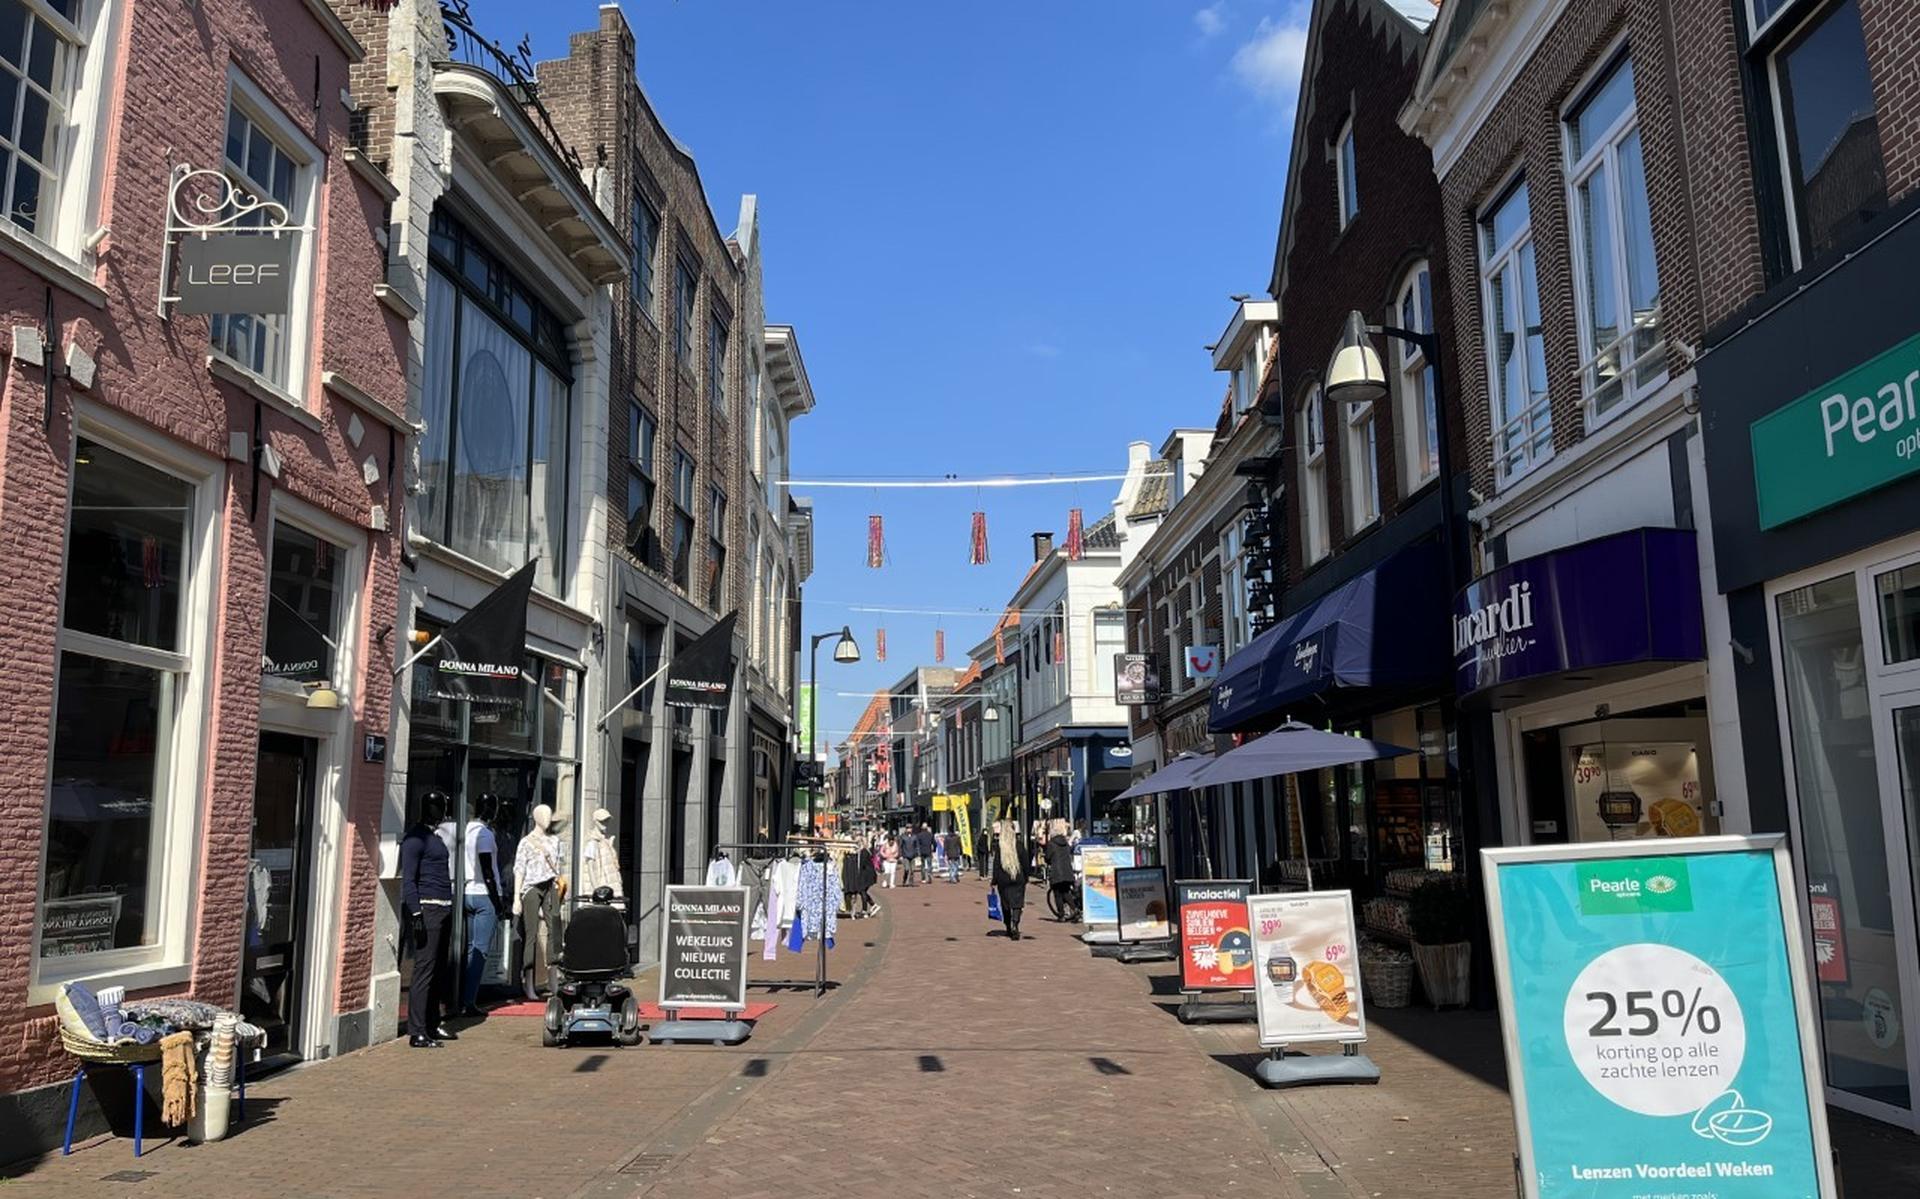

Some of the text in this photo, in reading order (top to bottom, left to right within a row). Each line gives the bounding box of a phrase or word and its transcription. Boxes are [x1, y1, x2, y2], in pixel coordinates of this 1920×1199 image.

[1820, 369, 1920, 458] Pear
[439, 660, 519, 675] DONNA MILANO
[669, 679, 727, 690] DONNA MILANO
[1590, 877, 1640, 892] Pearle
[671, 903, 740, 914] DONNA MILANO
[675, 935, 733, 947] WEKELIJKS
[681, 951, 726, 964] NIEUWE
[674, 967, 732, 980] COLLECTIE
[1585, 986, 1722, 1038] 25%
[1596, 1041, 1719, 1064] korting op alle
[1600, 1061, 1719, 1079] zachte lenzen
[1571, 1160, 1774, 1180] Lenzen Voordeel Weken
